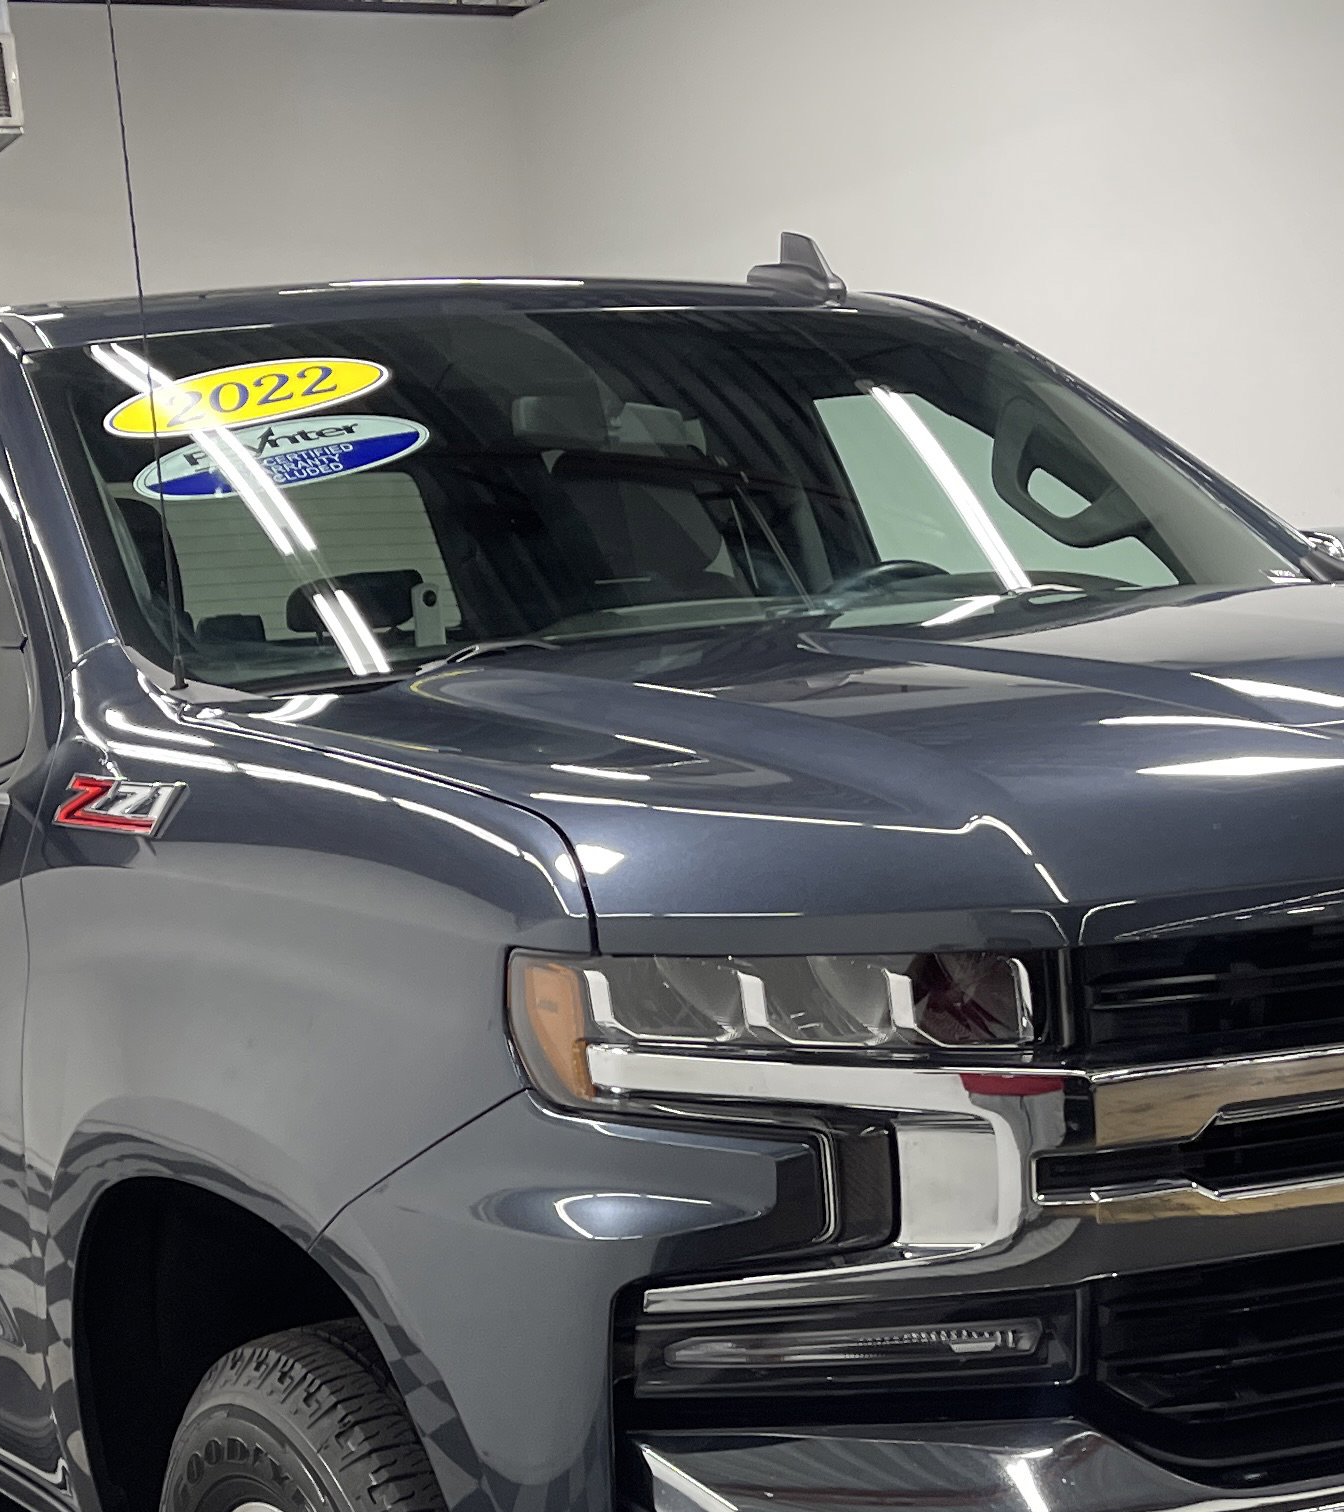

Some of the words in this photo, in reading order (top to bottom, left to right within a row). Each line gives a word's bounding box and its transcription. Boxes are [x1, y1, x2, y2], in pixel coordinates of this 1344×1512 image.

[166, 366, 339, 428] 2022
[262, 443, 354, 466] CERTIFIED
[271, 462, 344, 483] CLUDED
[52, 772, 189, 837] Z71
